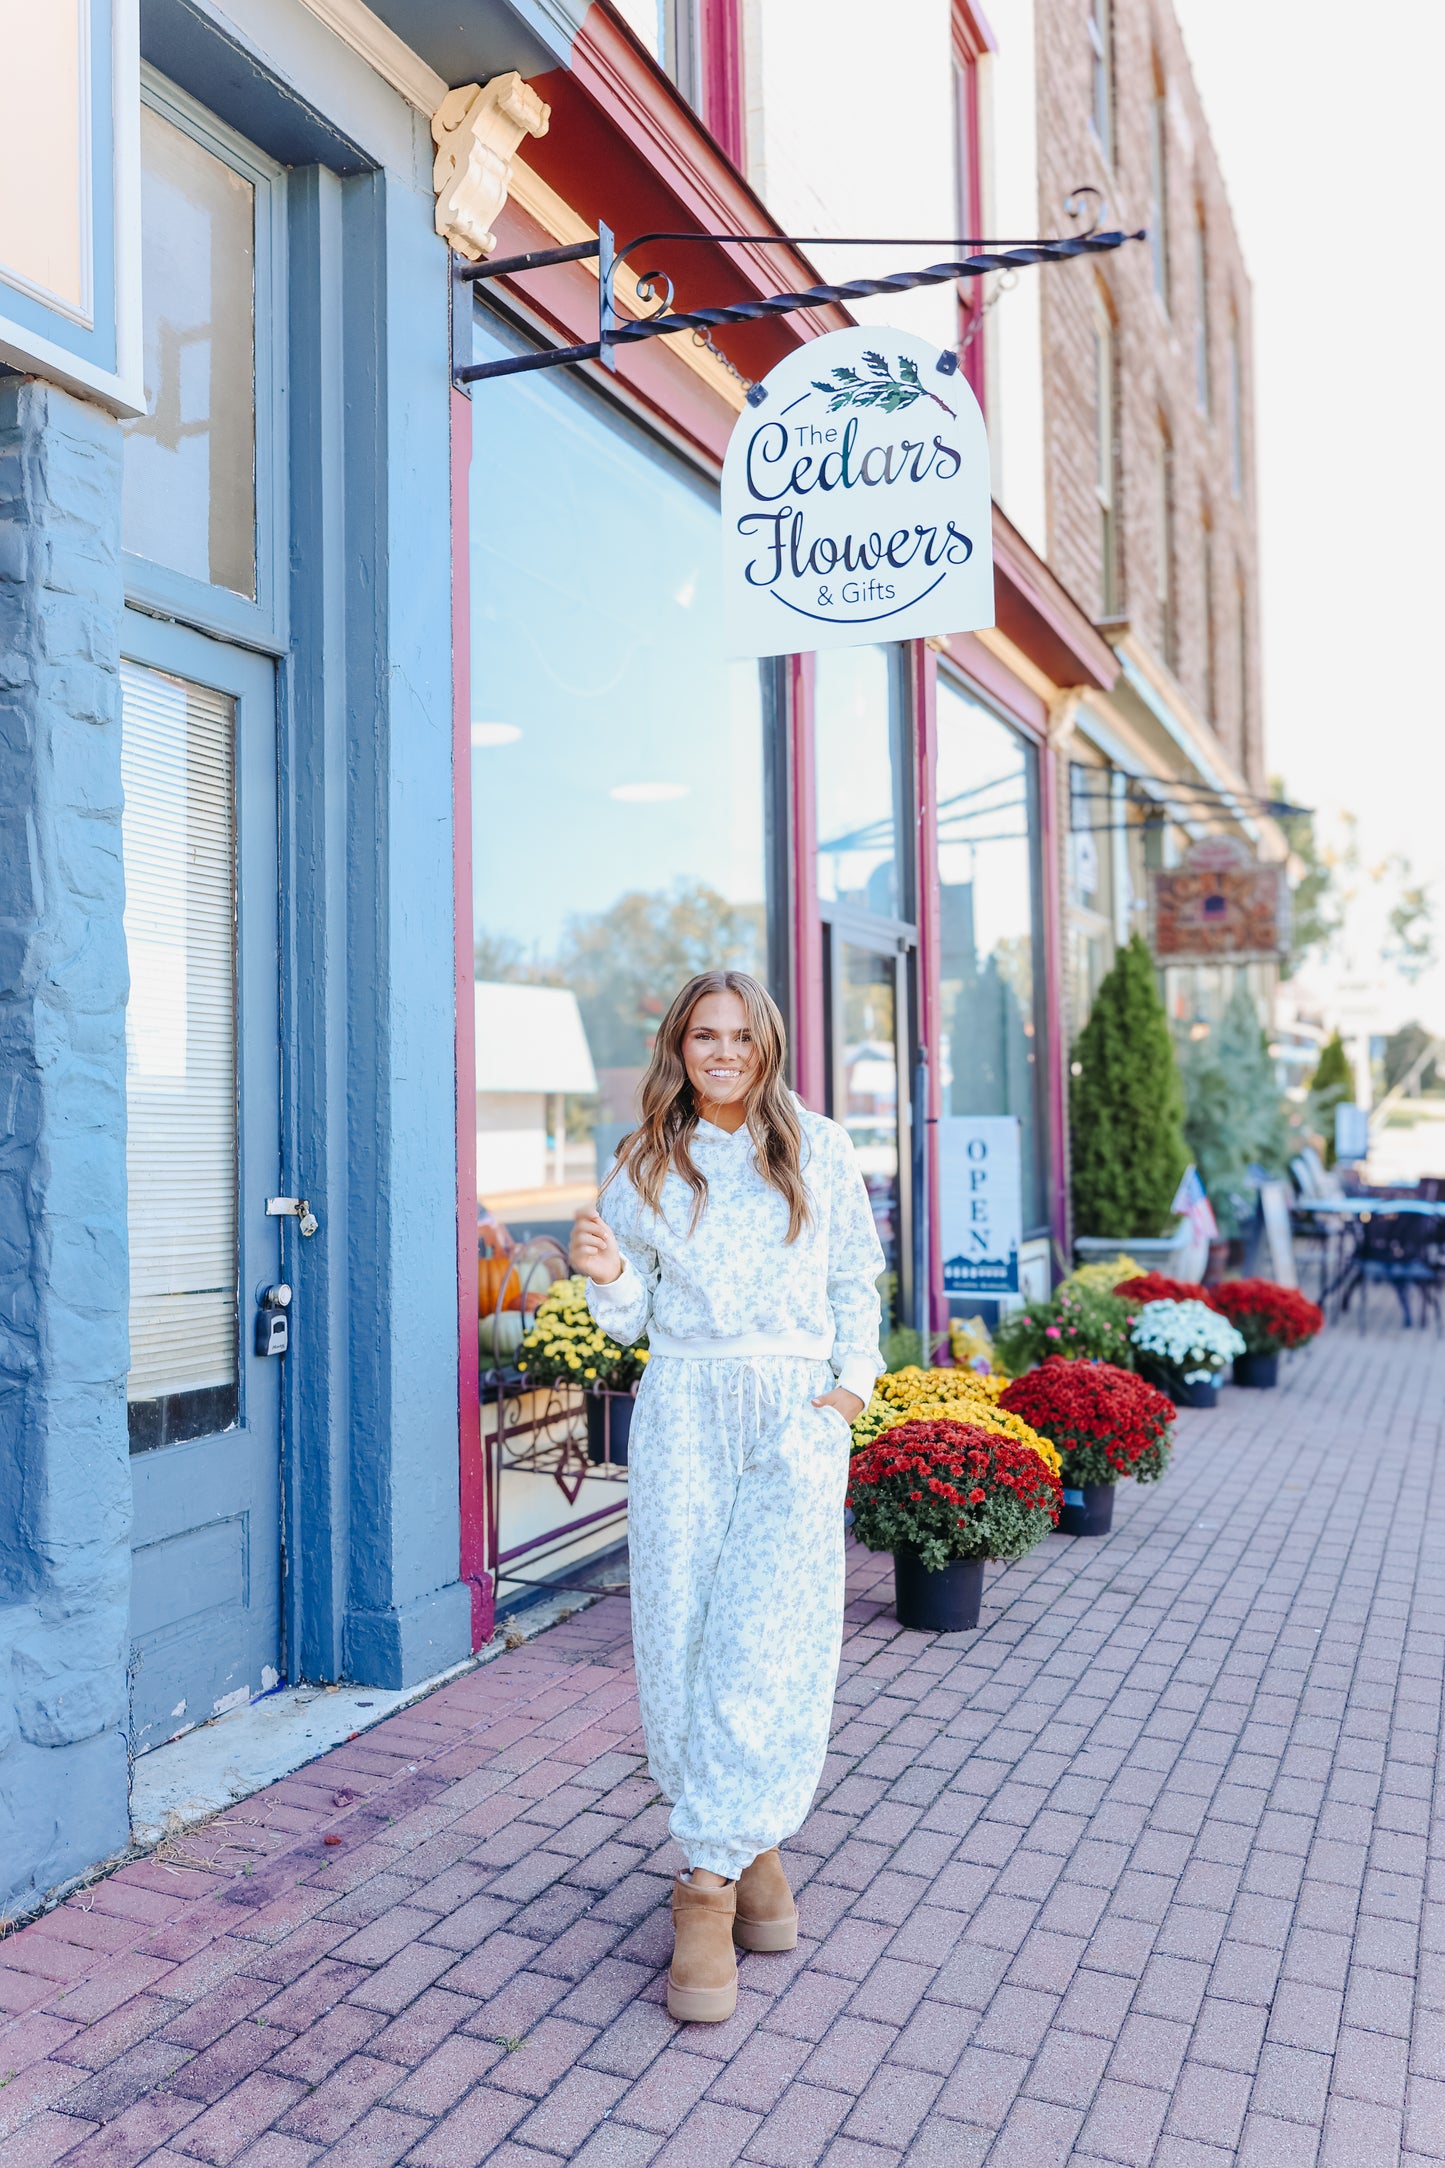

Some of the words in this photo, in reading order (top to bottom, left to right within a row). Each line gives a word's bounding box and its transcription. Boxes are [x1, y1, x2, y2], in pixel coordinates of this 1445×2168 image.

[746, 417, 962, 502] Cedars
[795, 425, 838, 447] The
[737, 505, 974, 587] Flowers
[817, 585, 834, 606] &
[841, 580, 896, 604] Gifts
[966, 1137, 990, 1253] OPEN
